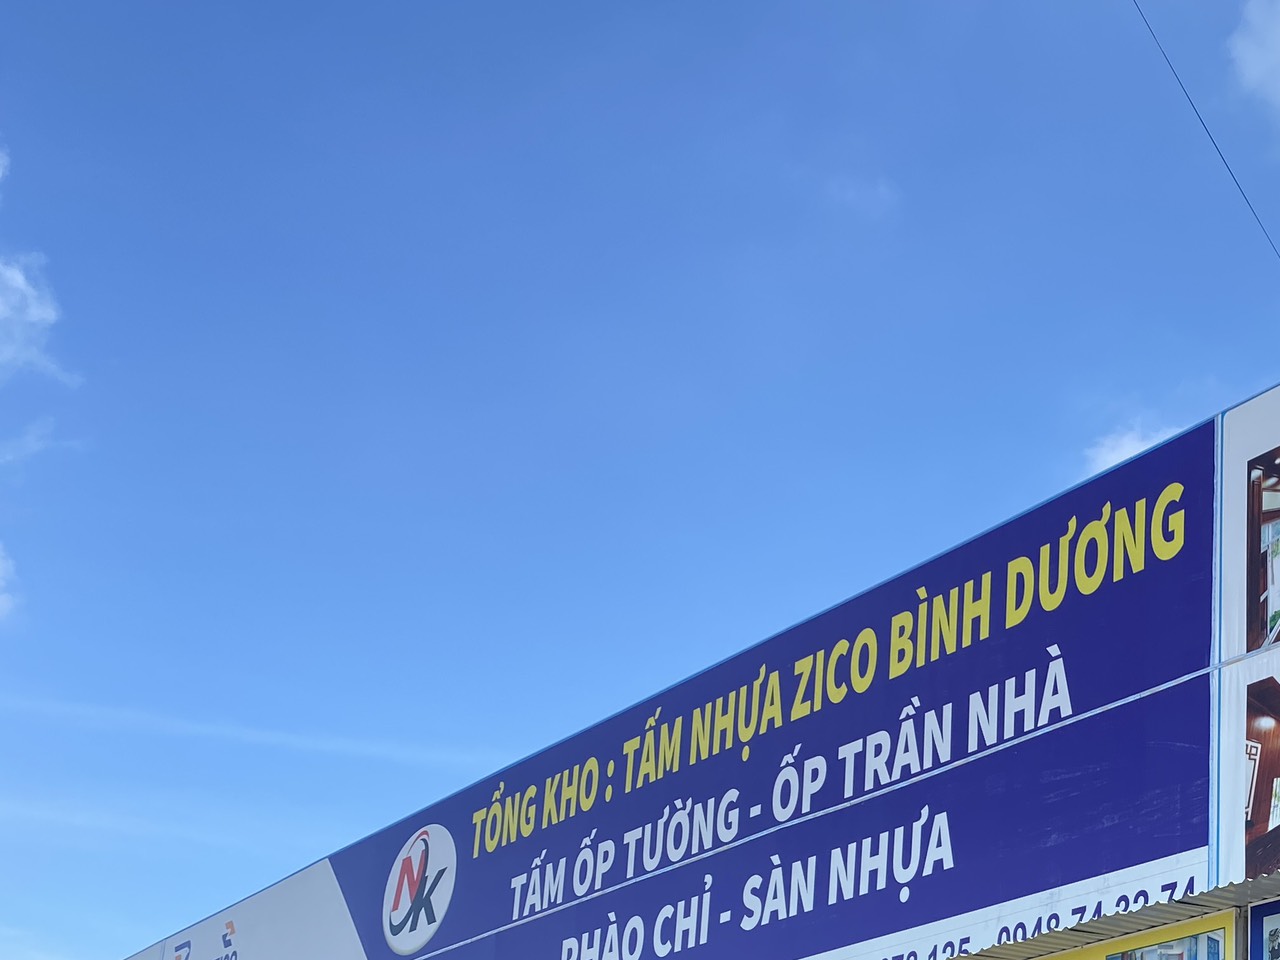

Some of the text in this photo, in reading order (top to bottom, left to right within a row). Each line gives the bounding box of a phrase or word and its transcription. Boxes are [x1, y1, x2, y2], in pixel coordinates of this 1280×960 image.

[472, 782, 535, 859] TỔNG
[542, 757, 598, 829] KHO
[622, 707, 681, 792] TẤM
[690, 663, 783, 763] NHỰA
[790, 628, 877, 722] ZICO
[889, 571, 992, 680] BÌNH
[1005, 481, 1186, 630] DƯƠNG
[510, 852, 566, 921] TẤM
[573, 829, 614, 897] ỐP
[623, 789, 740, 879] TƯỜNG
[772, 745, 826, 823] ỐP
[838, 697, 951, 798] TRẦN
[967, 643, 1073, 754] NHÀ
[653, 872, 711, 958] CHỈ
[740, 852, 817, 932] SÀN
[827, 806, 955, 904] NHỰA
